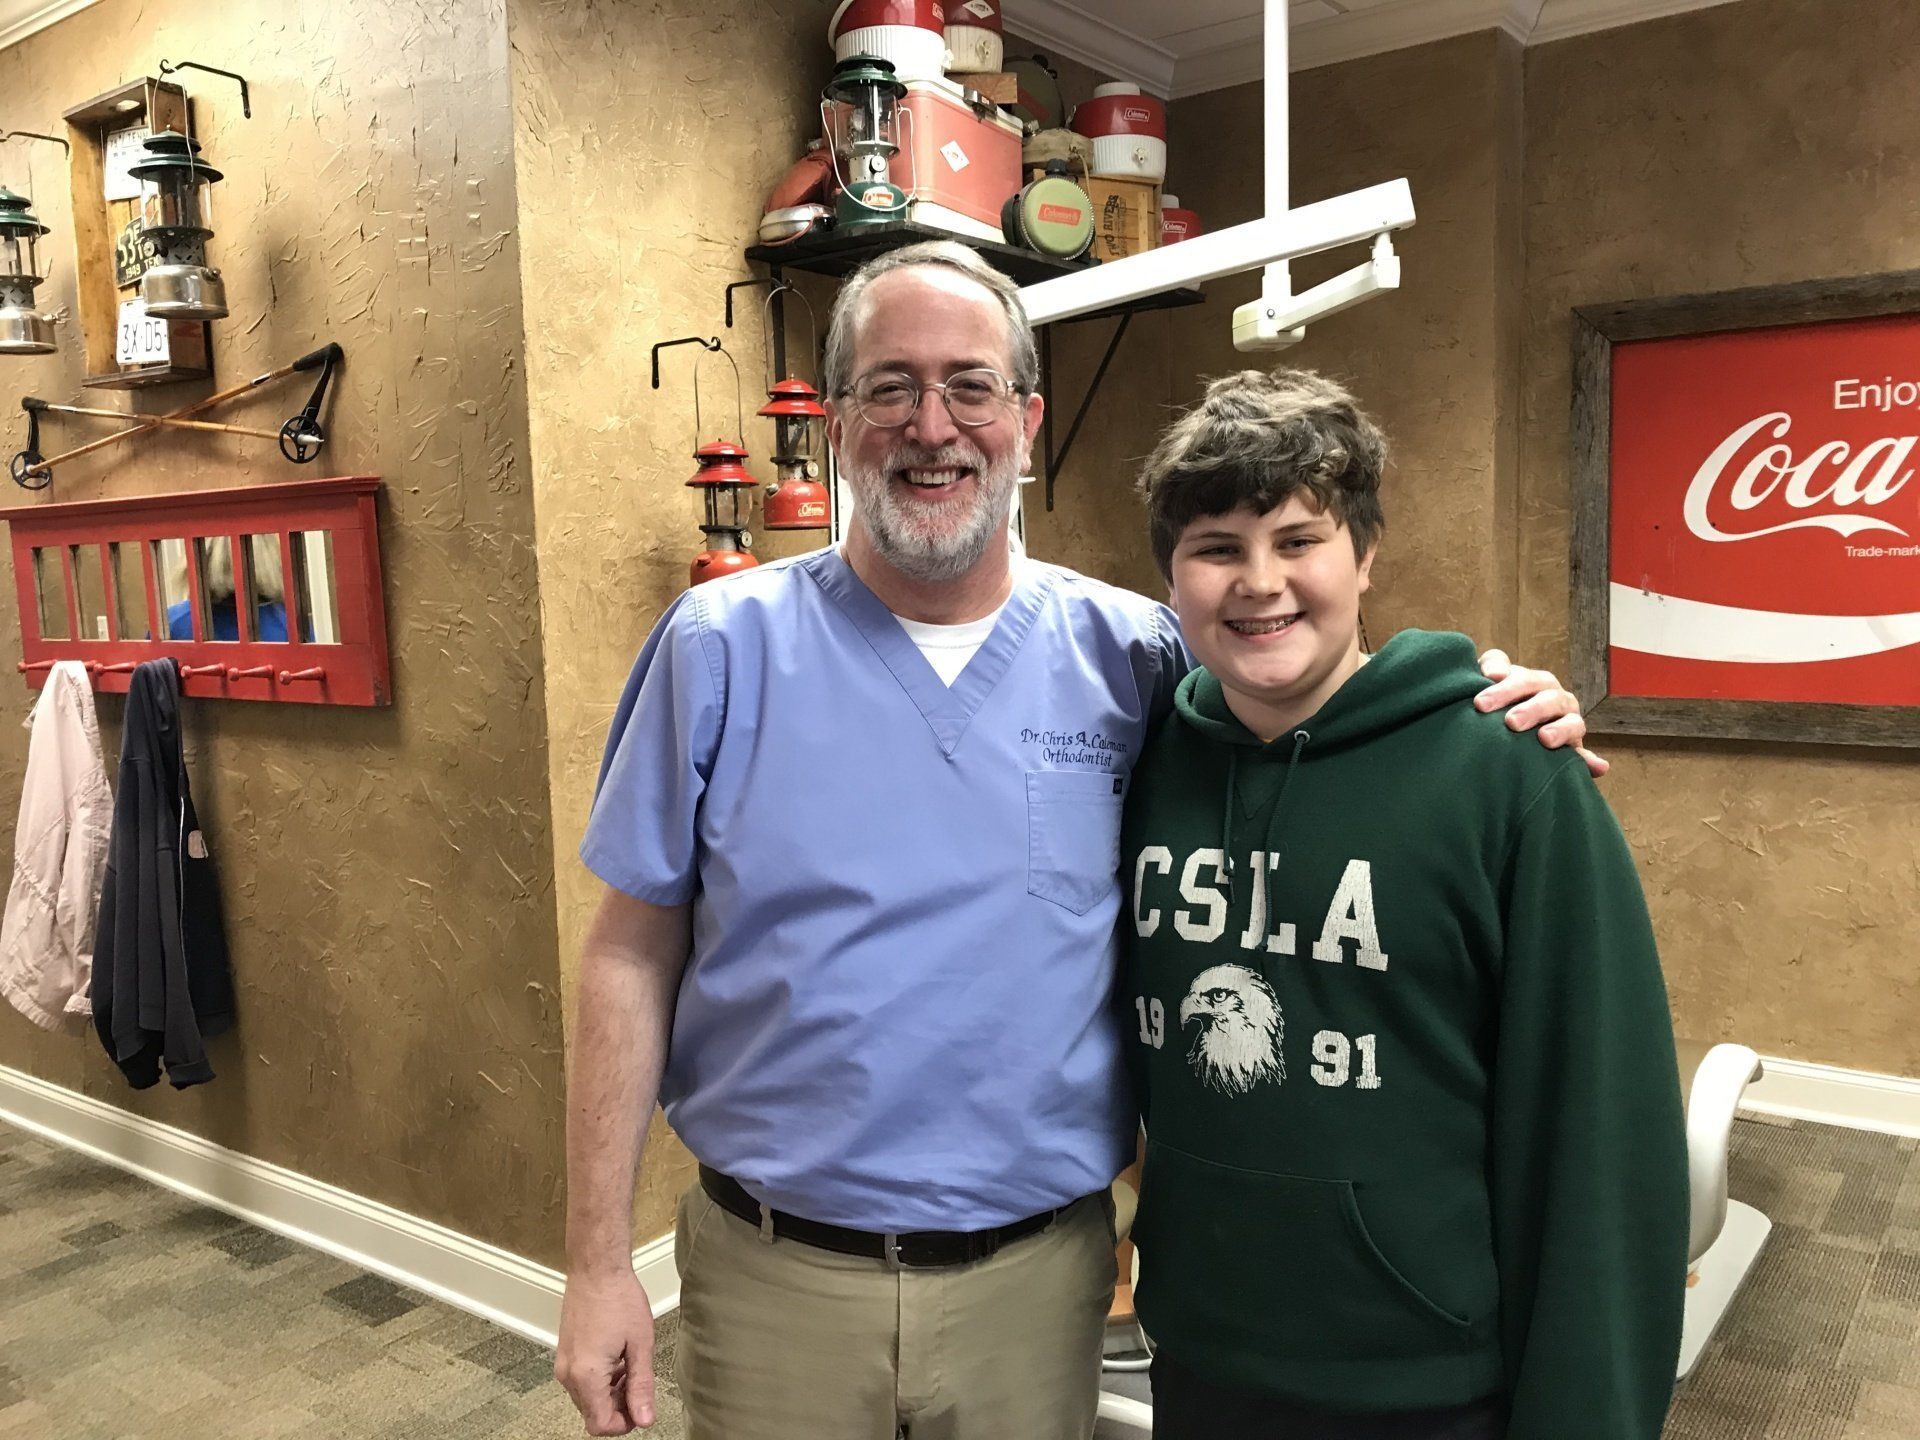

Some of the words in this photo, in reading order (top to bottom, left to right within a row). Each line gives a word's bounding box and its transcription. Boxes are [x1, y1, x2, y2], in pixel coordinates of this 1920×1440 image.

[1834, 376, 1920, 412] Enjo
[1684, 411, 1919, 543] Coca
[1042, 747, 1113, 767] Orthodontist
[1134, 846, 1389, 972] CSLA
[1135, 994, 1165, 1049] 19
[1310, 1029, 1382, 1089] 91
